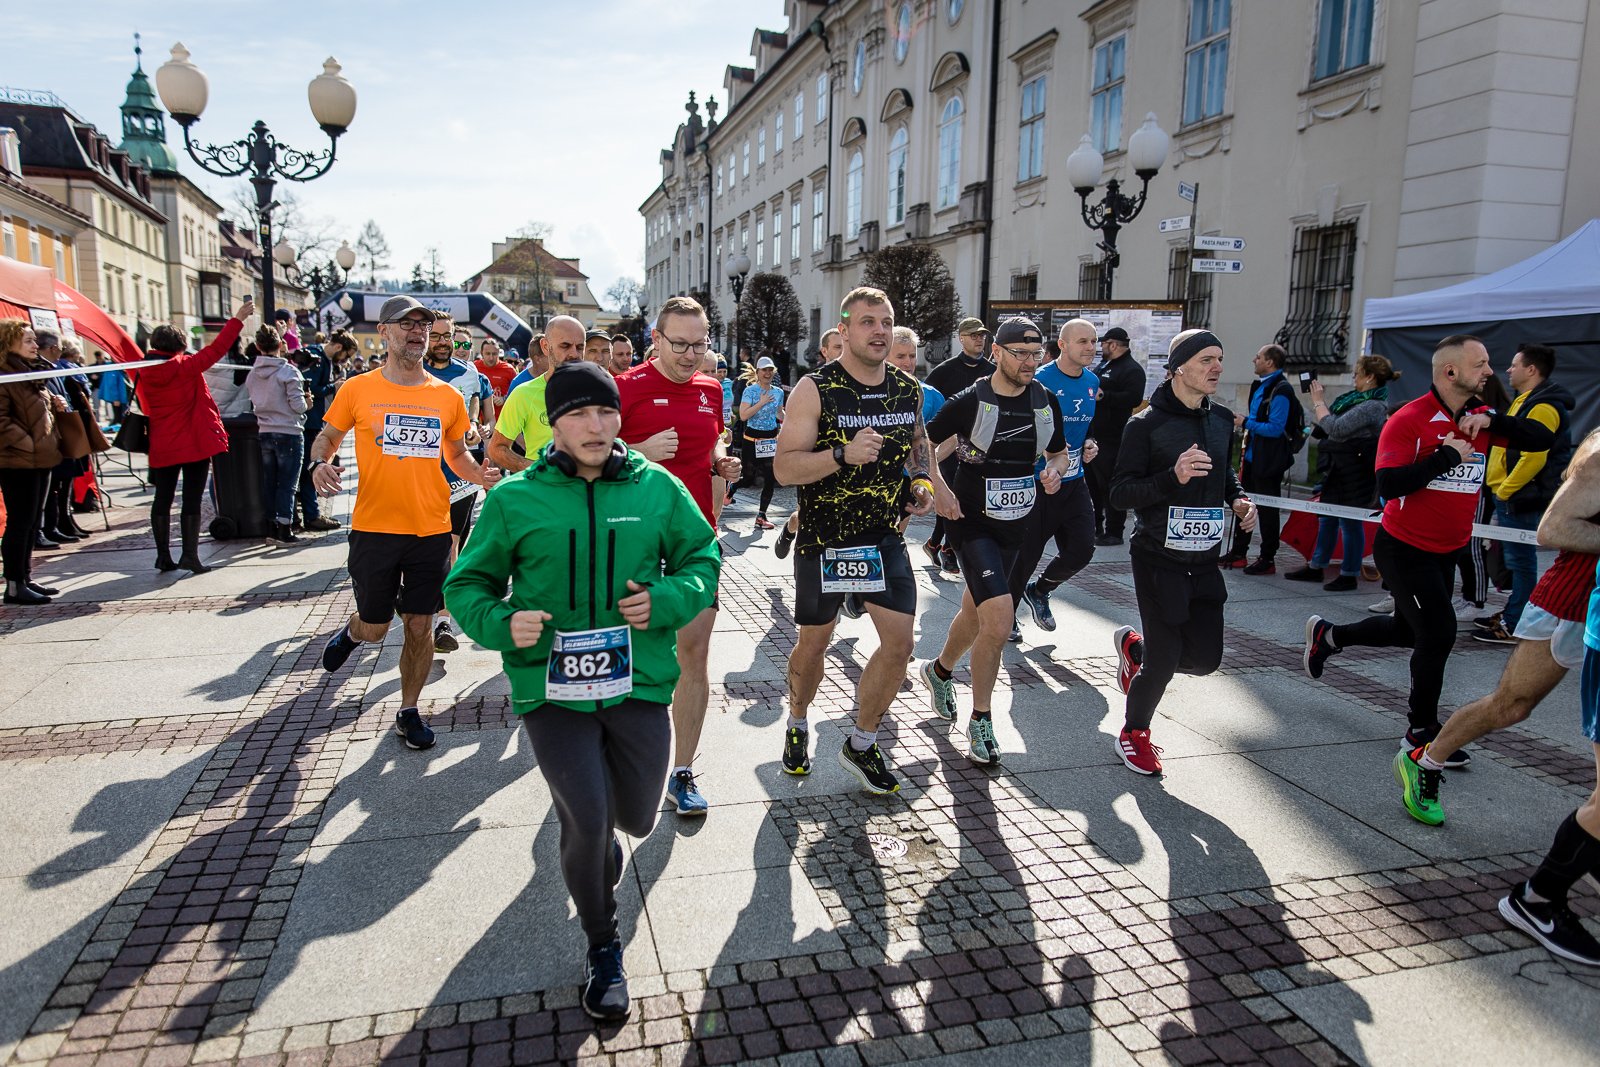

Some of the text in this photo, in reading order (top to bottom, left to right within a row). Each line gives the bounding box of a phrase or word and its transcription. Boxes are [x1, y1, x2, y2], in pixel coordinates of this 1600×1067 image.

[837, 411, 916, 428] RUNMAGEDDON
[399, 428, 428, 443] 573
[761, 444, 774, 452] 576
[1001, 491, 1025, 506] 803
[1183, 522, 1210, 536] 559
[837, 561, 868, 577] 859
[563, 652, 611, 678] 862
